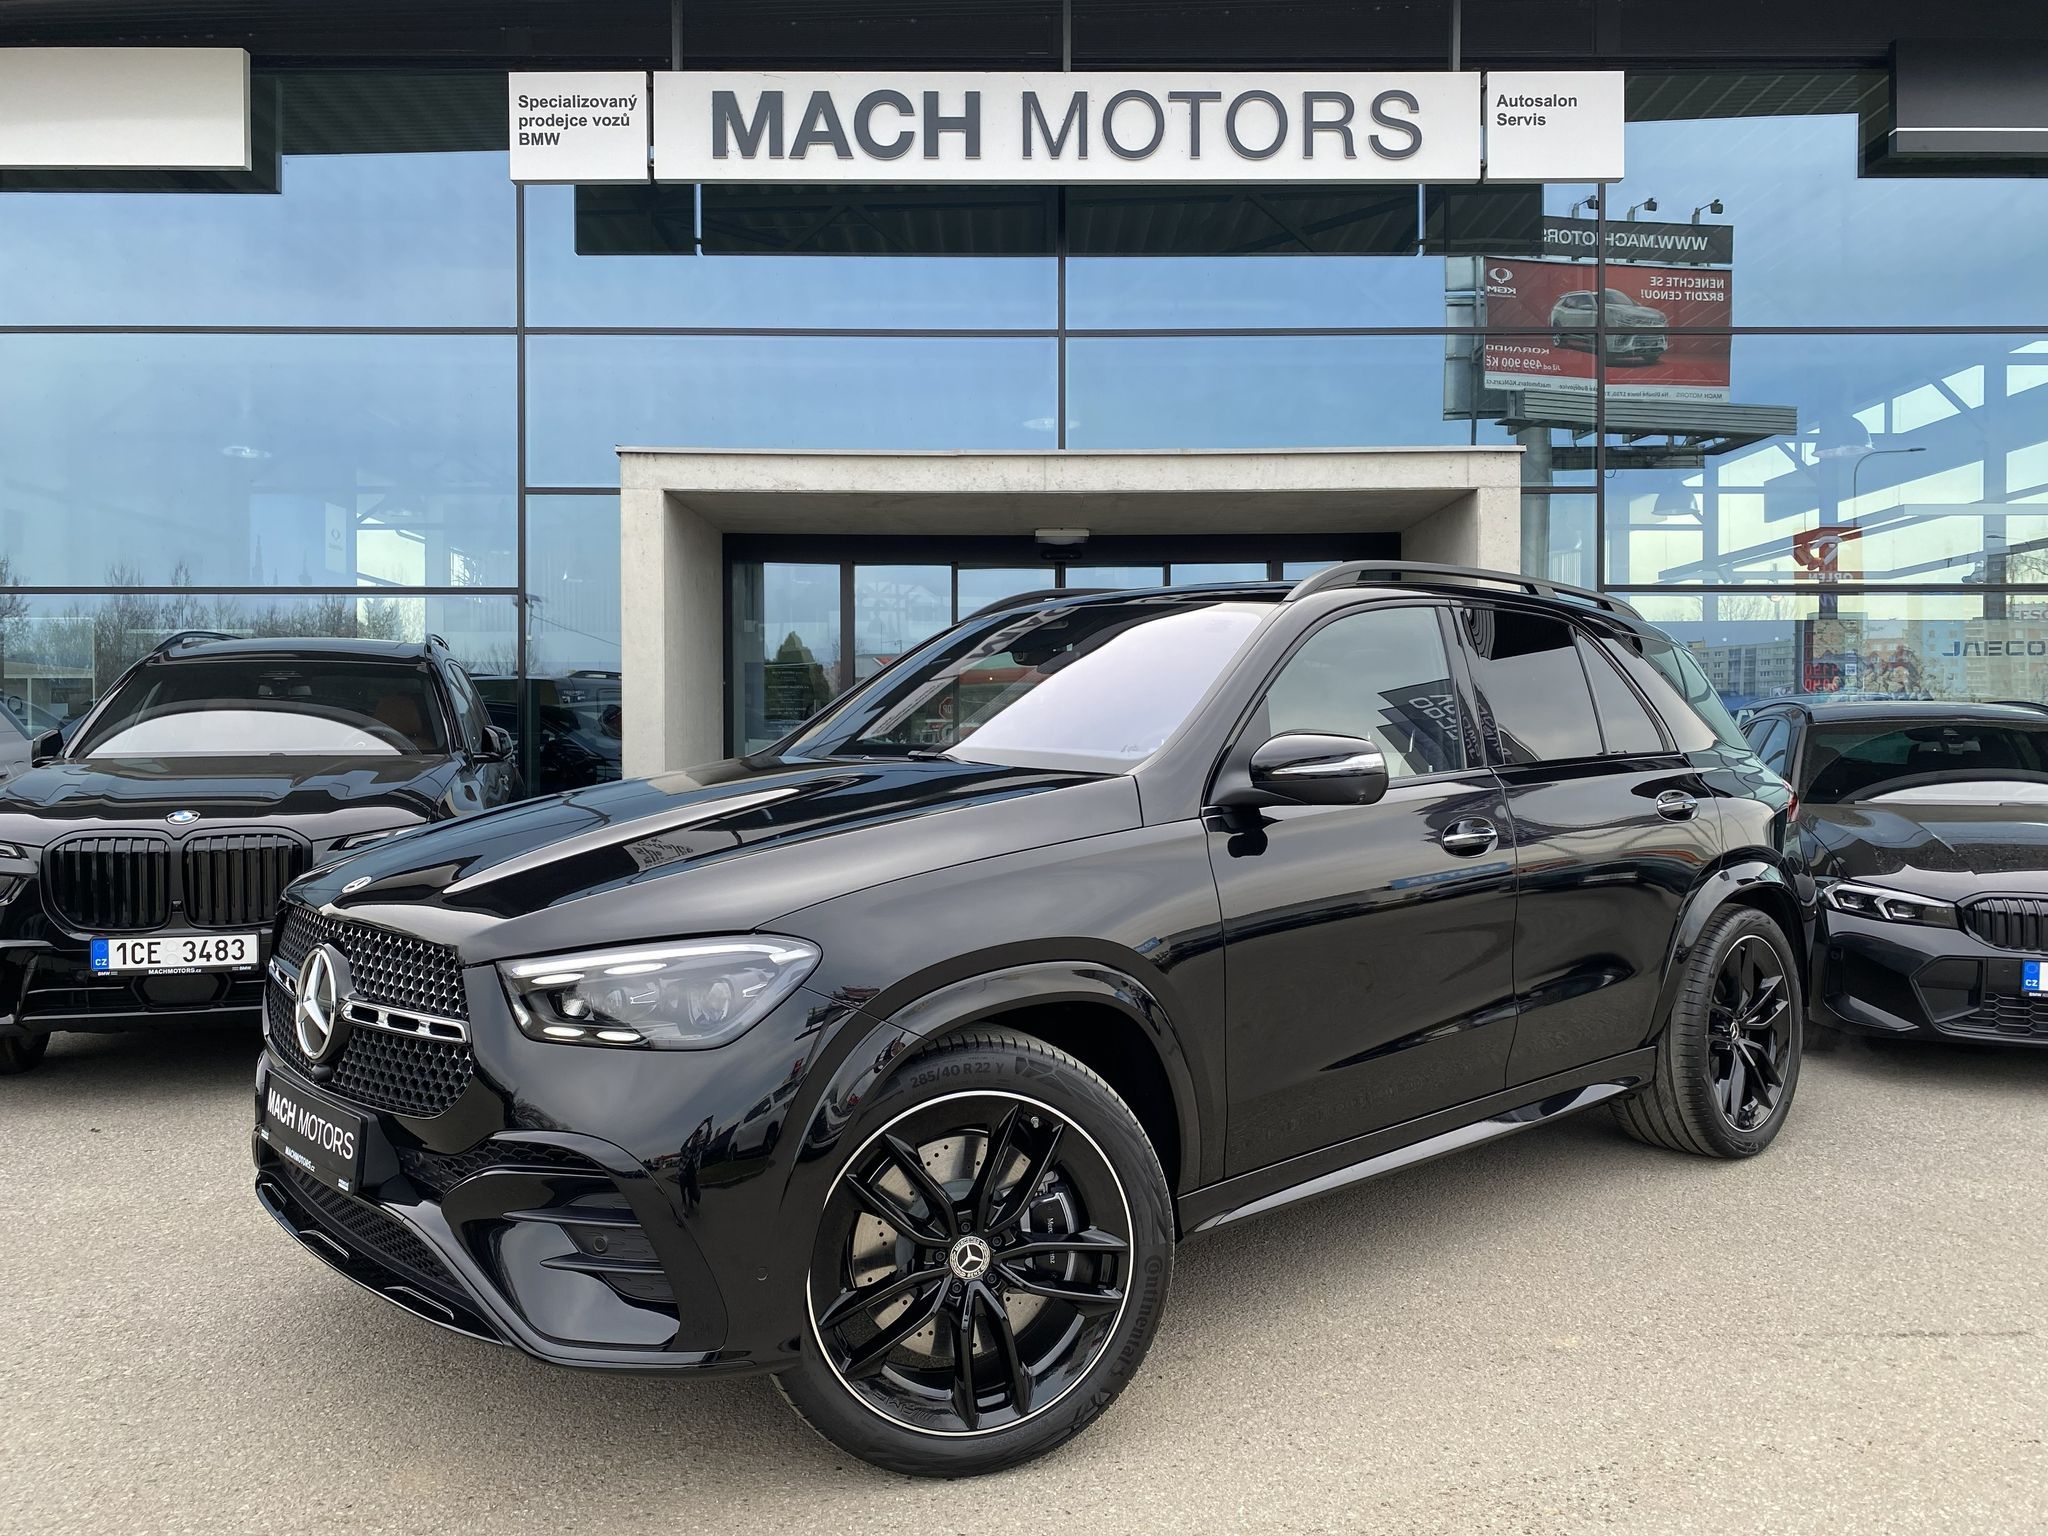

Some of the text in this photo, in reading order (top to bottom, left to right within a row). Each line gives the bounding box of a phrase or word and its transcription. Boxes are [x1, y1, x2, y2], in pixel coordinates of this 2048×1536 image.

[517, 93, 638, 112] Specializovaný
[1496, 93, 1579, 109] Autosalon
[518, 112, 631, 130] prodejce vozů
[711, 88, 1424, 161] MACH MOTORS
[1496, 111, 1547, 127] Servis
[518, 132, 561, 146] BMW
[116, 938, 246, 966] 1CE 3483
[95, 958, 108, 966] CZ
[2025, 979, 2038, 987] CZ
[267, 1087, 355, 1161] MACH MOTORS
